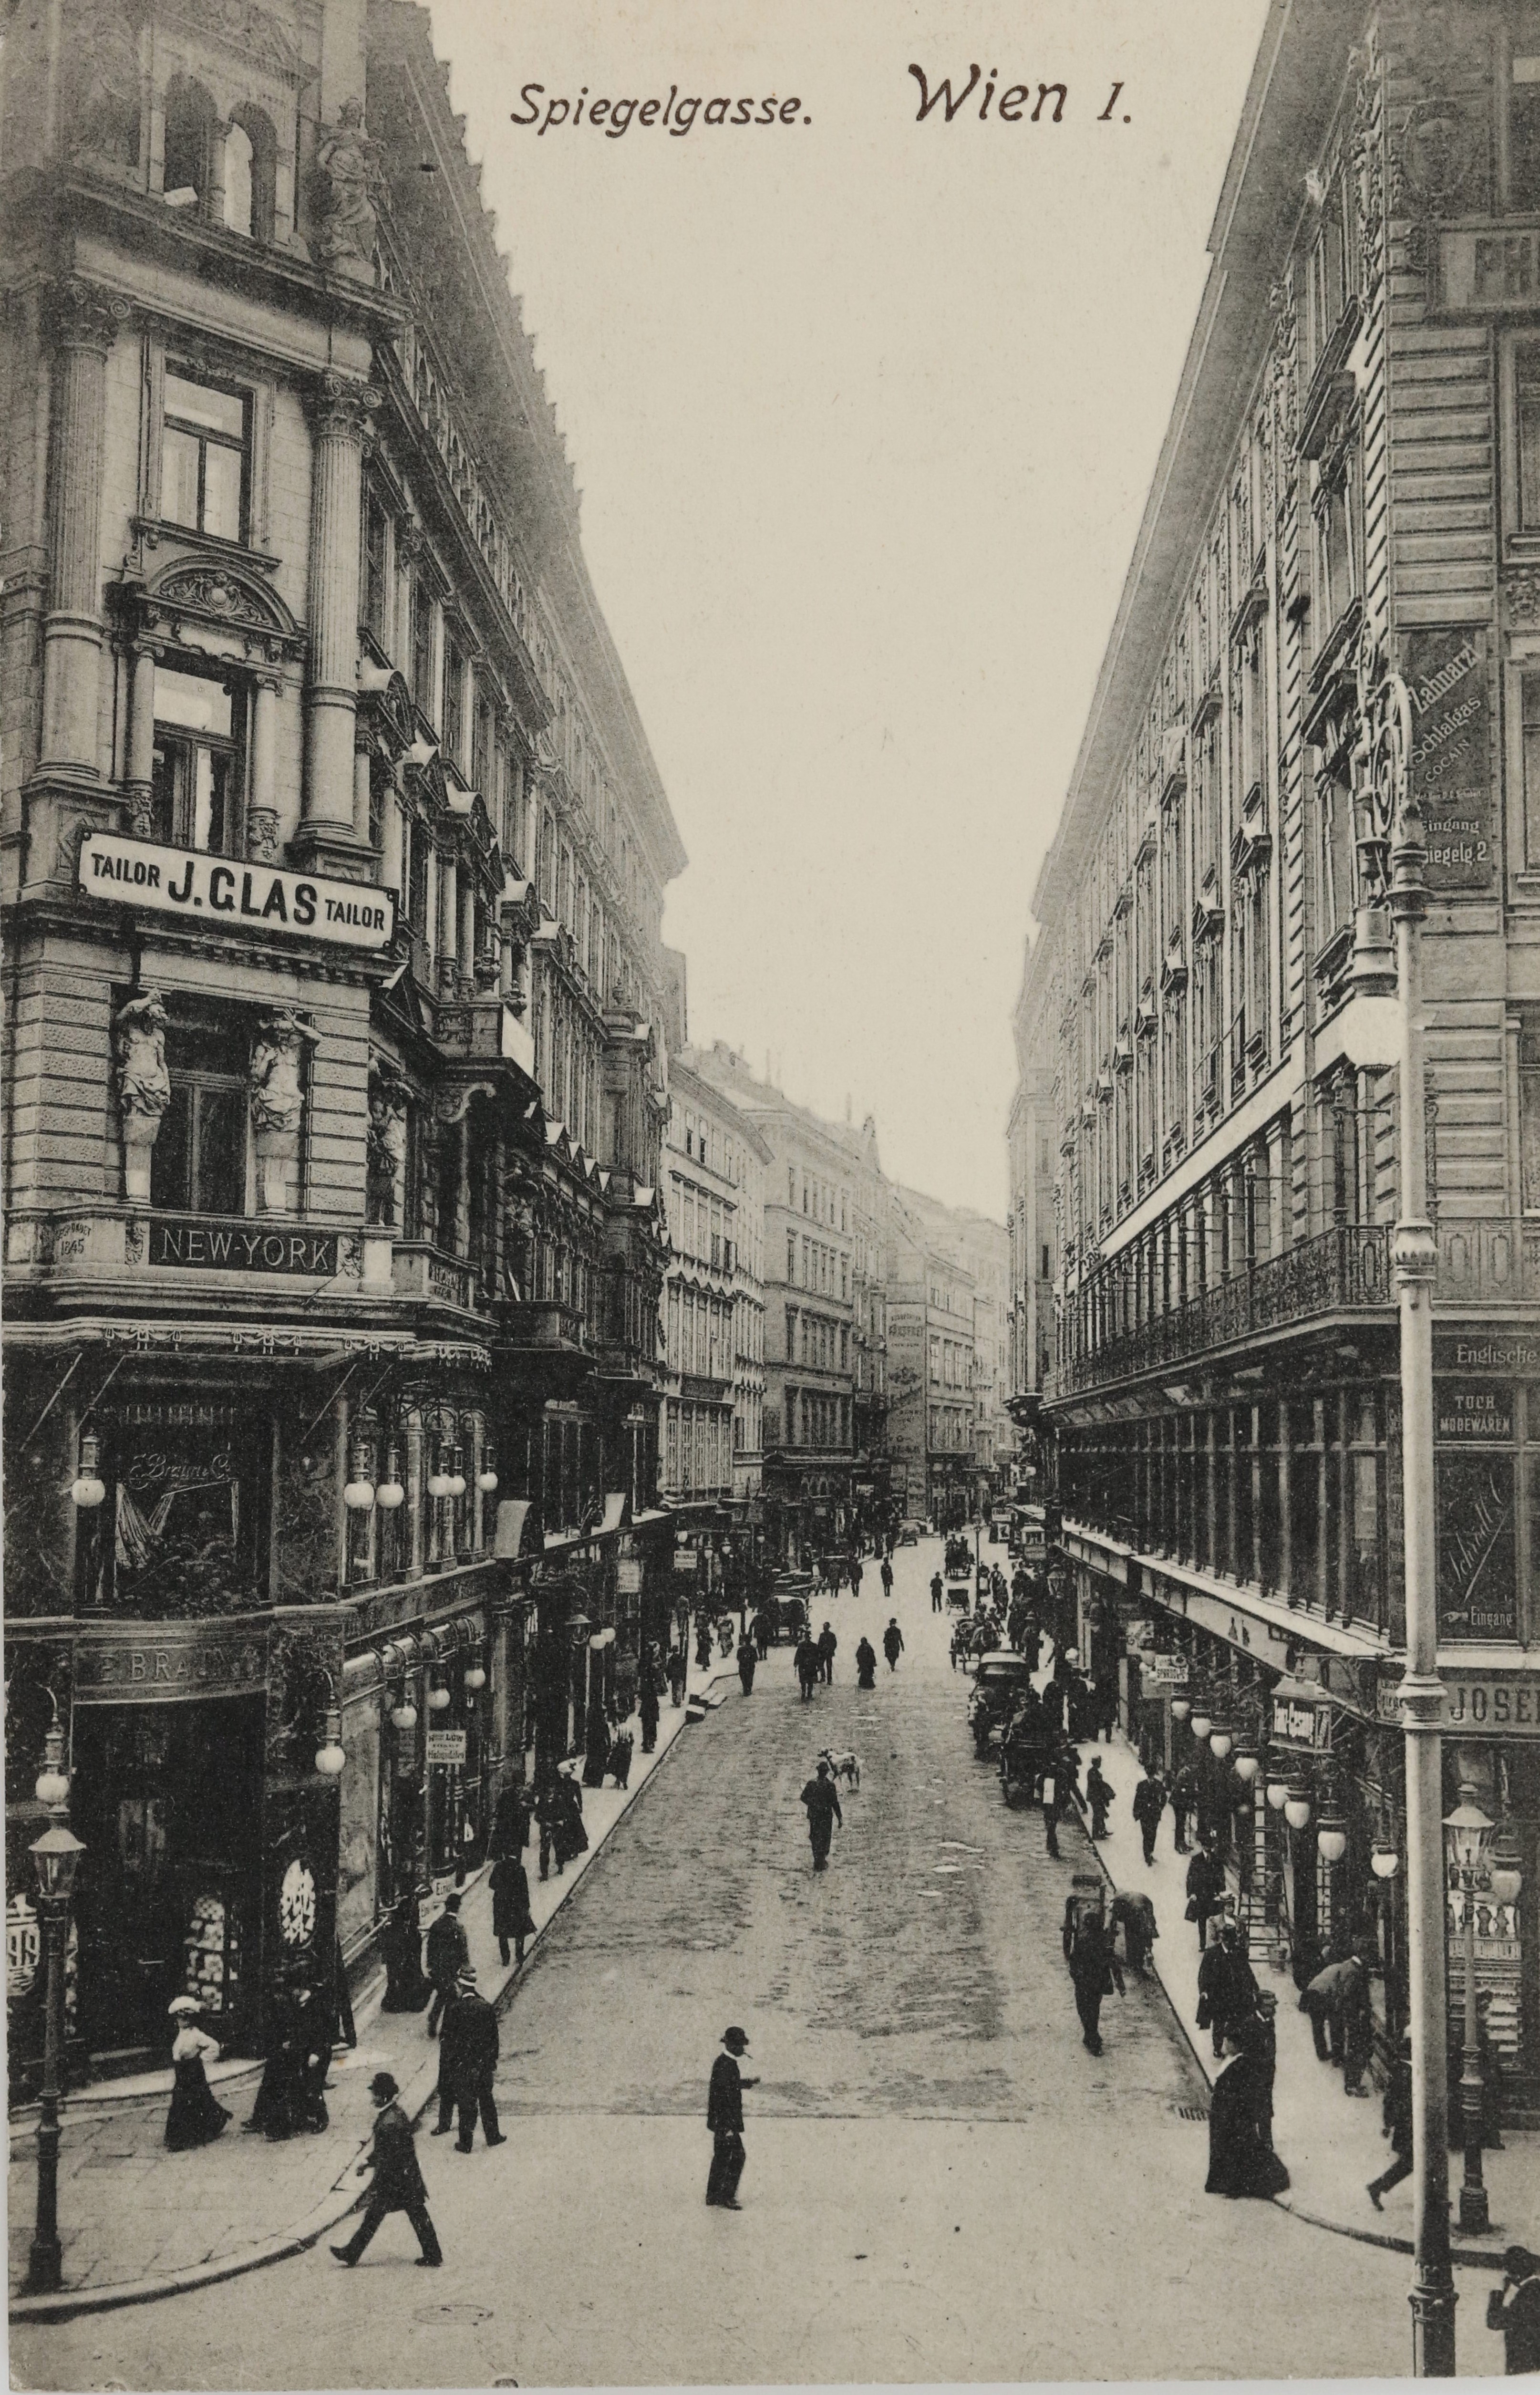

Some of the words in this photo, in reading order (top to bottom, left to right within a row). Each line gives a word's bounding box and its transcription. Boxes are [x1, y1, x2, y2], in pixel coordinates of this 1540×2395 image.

[1407, 639, 1481, 714] Zahnarzt
[1425, 739, 1469, 782] COCAIN
[91, 853, 160, 888] TAILOR
[325, 899, 385, 931] TAILOR
[61, 1238, 85, 1256] 1845
[1457, 1344, 1537, 1365] Englische
[1456, 1395, 1495, 1409] TUCH
[1440, 1417, 1511, 1432] MODEWAREN
[1471, 1606, 1513, 1628] Eingang
